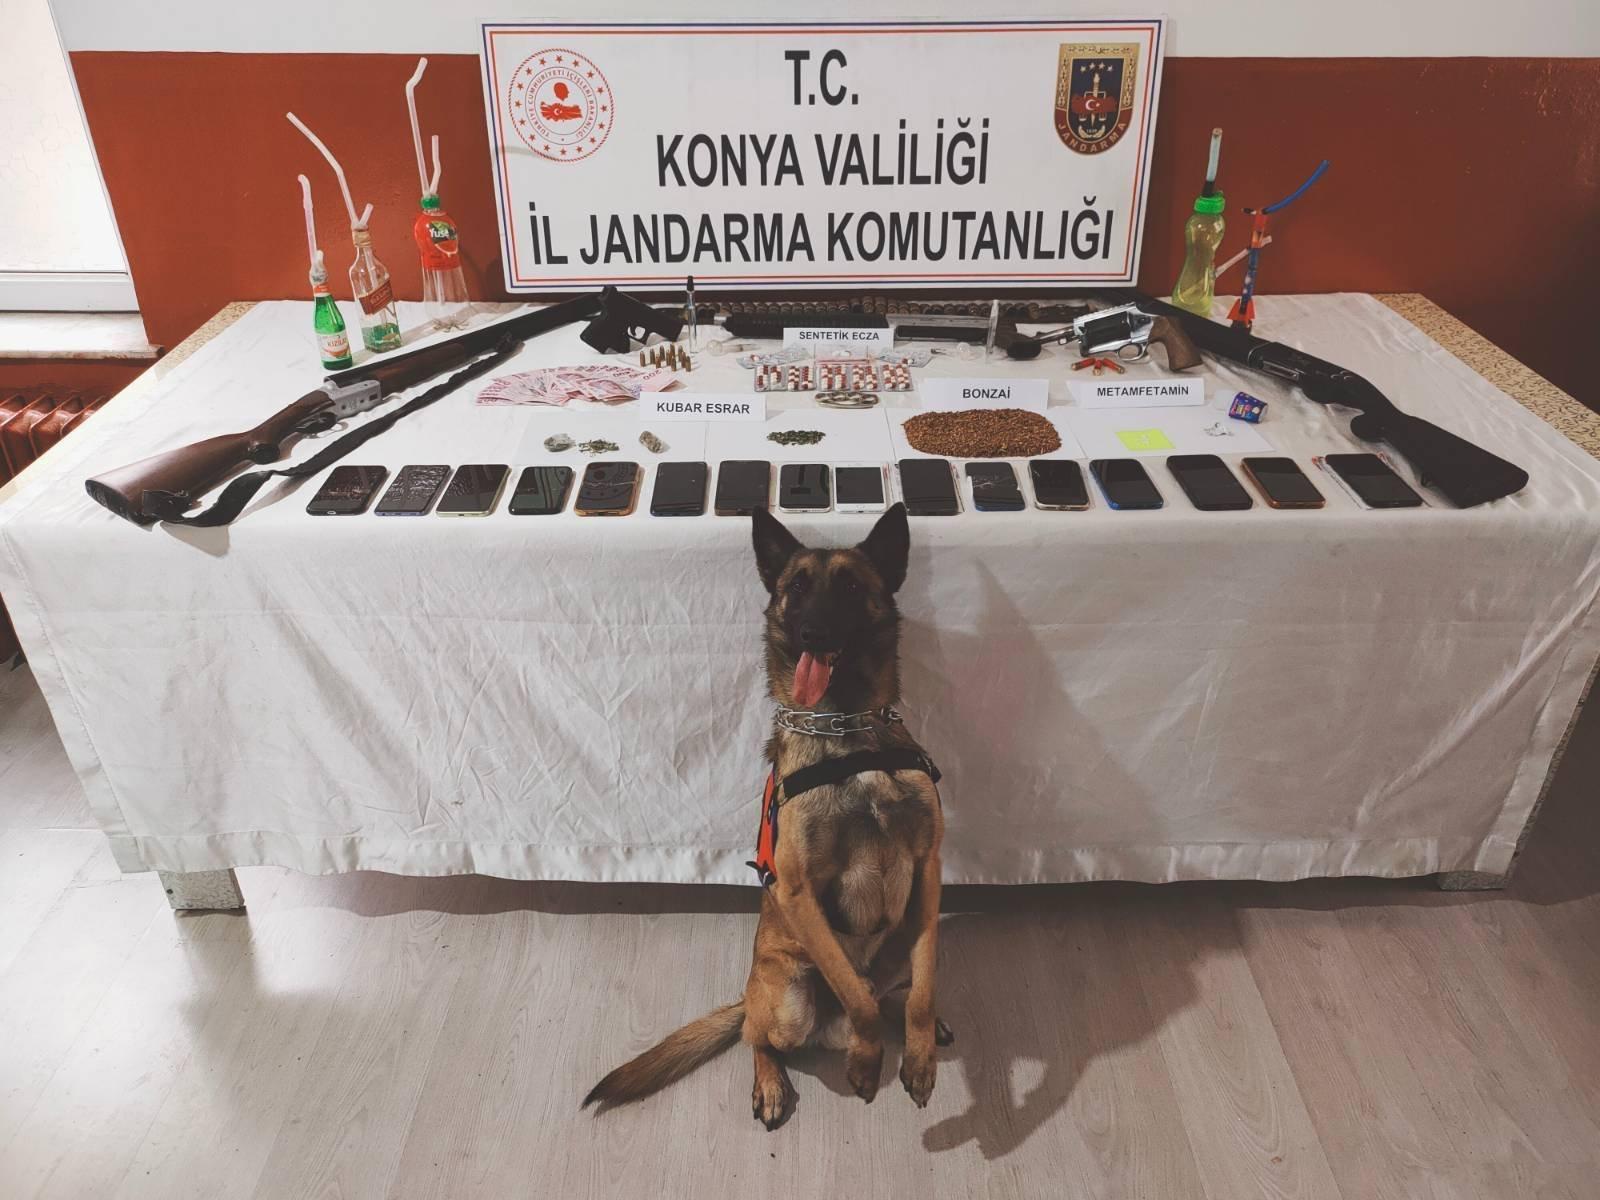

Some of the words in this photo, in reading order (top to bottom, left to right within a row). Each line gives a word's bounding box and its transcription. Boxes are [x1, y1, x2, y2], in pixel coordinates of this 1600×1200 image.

[784, 49, 859, 106] T.C.
[1058, 122, 1127, 153] JANDARMA
[656, 133, 805, 188] KONYA
[814, 117, 990, 186] VALİLİĞİ
[528, 201, 569, 265] İL
[579, 212, 815, 265] JANDARMA
[827, 195, 1114, 262] KOMUTANLIĞI
[799, 330, 849, 341] SENTETİK
[852, 331, 880, 341] ECZA
[962, 386, 1011, 400] BONZAİ
[1097, 384, 1189, 397] METAMFETAMİN
[656, 402, 702, 413] KUBAR
[706, 403, 750, 415] ESRAR
